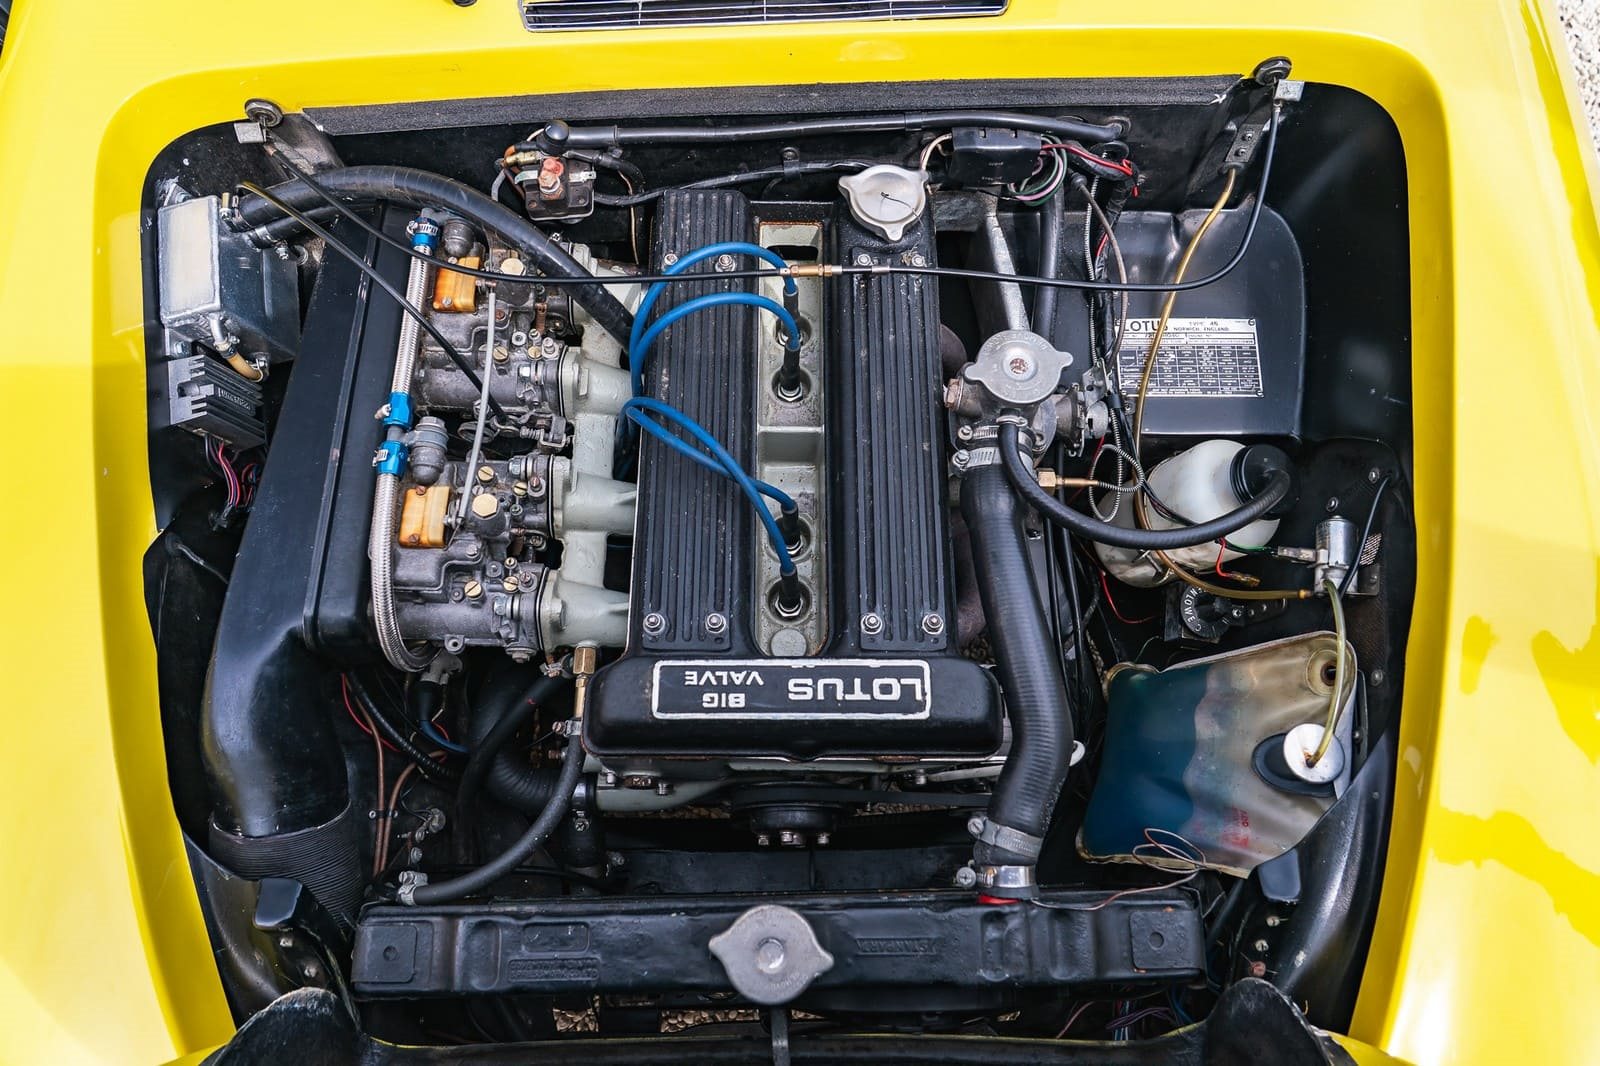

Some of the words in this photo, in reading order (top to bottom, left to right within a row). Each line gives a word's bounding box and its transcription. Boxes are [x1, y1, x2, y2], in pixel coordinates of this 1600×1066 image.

[684, 670, 764, 687] VALVE
[788, 677, 924, 701] LOTUS
[702, 693, 746, 708] BIG
